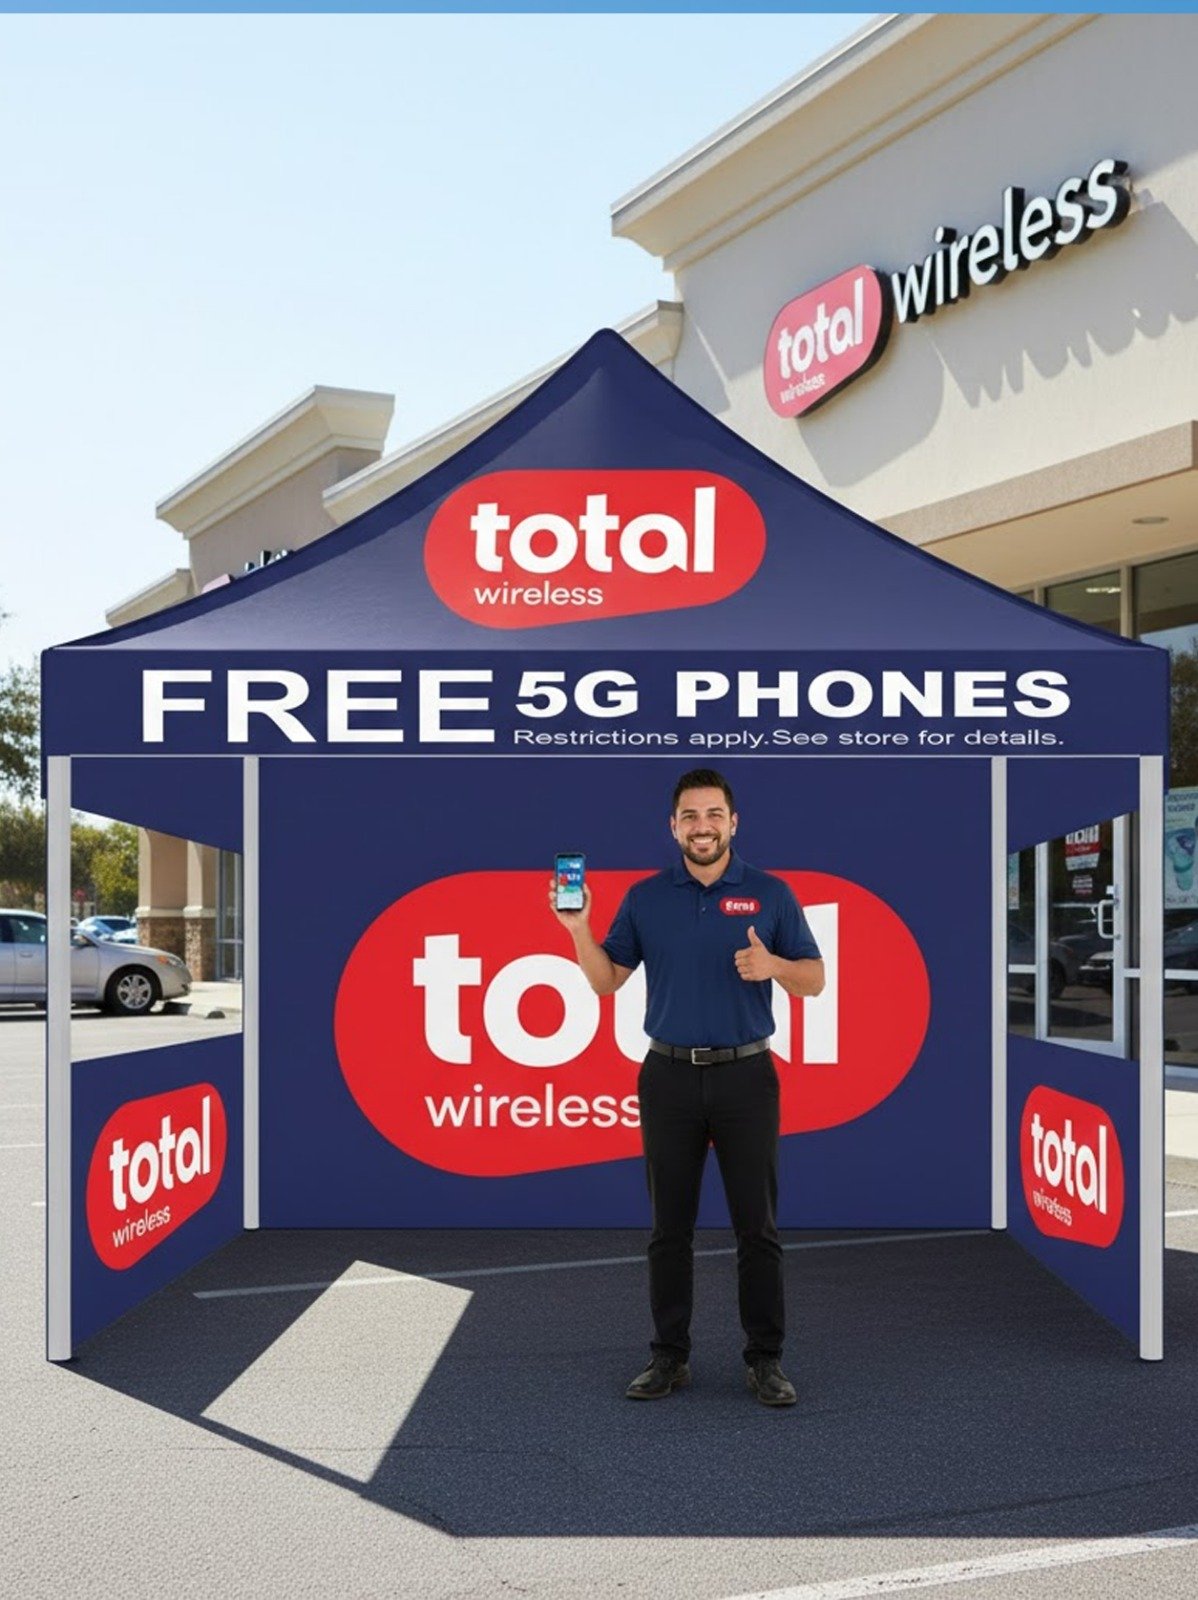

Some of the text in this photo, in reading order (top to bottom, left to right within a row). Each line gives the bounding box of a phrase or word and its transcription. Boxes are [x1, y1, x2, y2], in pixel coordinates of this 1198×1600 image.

[777, 160, 1118, 379] total wireless
[470, 486, 716, 574] total
[473, 580, 604, 607] wireless
[142, 669, 1071, 743] FREE 5G PHONES
[513, 728, 679, 746] Restrictions
[838, 730, 909, 746] store
[918, 729, 955, 746] for
[964, 728, 1065, 746] details.
[413, 902, 839, 1069] tol
[424, 1083, 641, 1128] wireless
[109, 1095, 211, 1211] total
[1031, 1112, 1108, 1215] total
[112, 1205, 171, 1249] wireless
